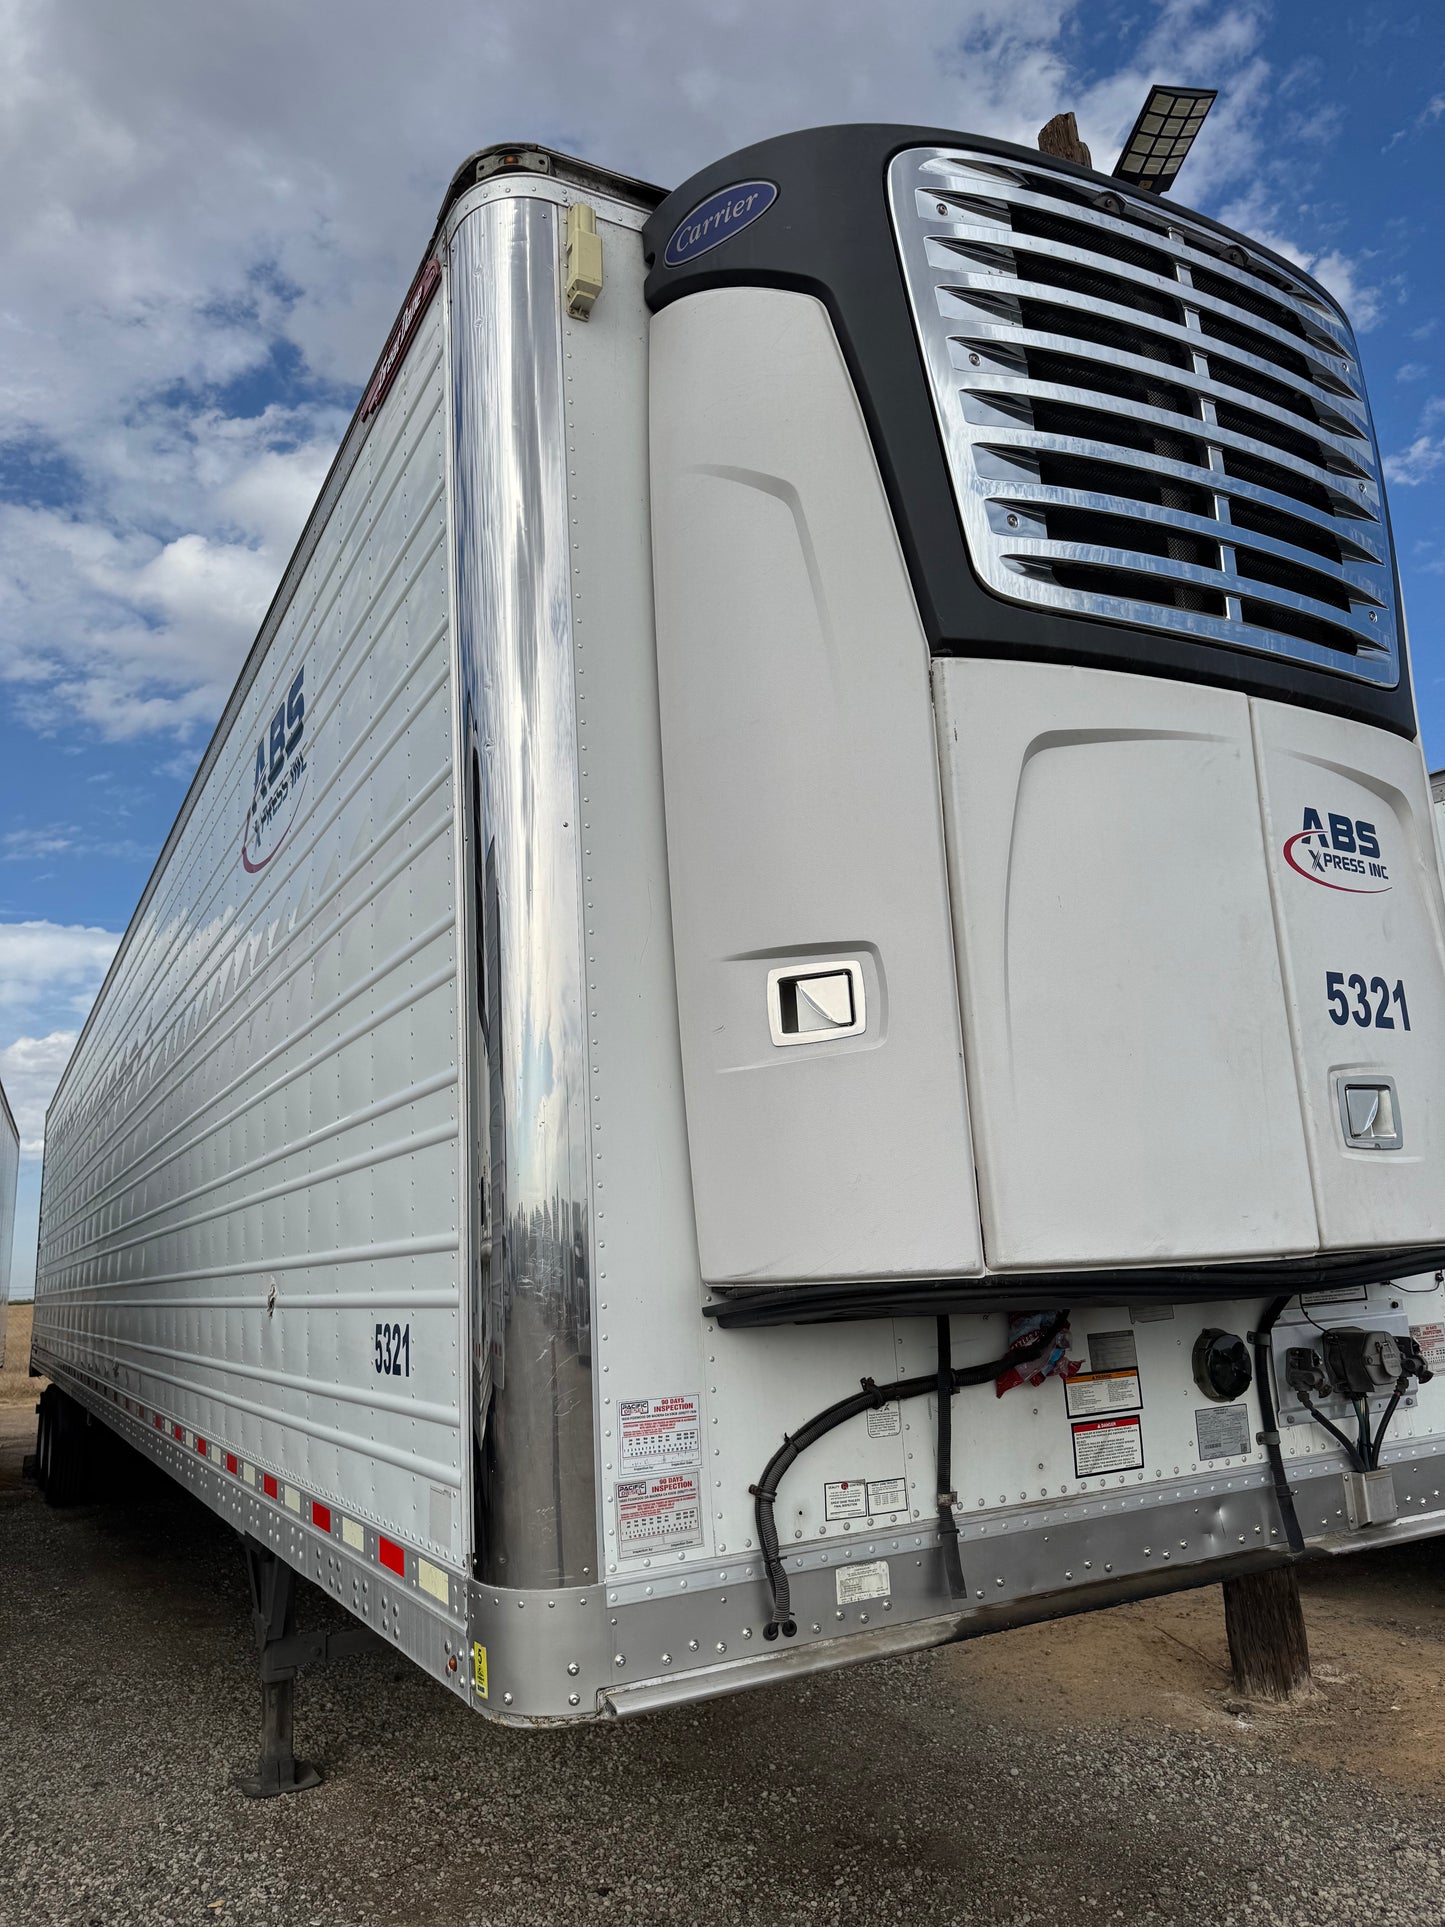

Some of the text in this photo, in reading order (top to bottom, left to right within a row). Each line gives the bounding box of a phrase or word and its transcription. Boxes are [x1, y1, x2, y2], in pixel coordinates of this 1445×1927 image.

[677, 193, 758, 252] Carrier
[252, 664, 305, 816] ABS
[1301, 807, 1380, 859] ABS
[1308, 849, 1389, 880] XPRESS INC
[1326, 971, 1411, 1031] 5321
[375, 1323, 410, 1377] 5321
[622, 1402, 647, 1410] PACIFIC
[654, 1403, 693, 1413] INSPECTION
[620, 1484, 645, 1492] PACIFIC
[652, 1481, 693, 1493] INSPECTION
[478, 1649, 482, 1665] 5
